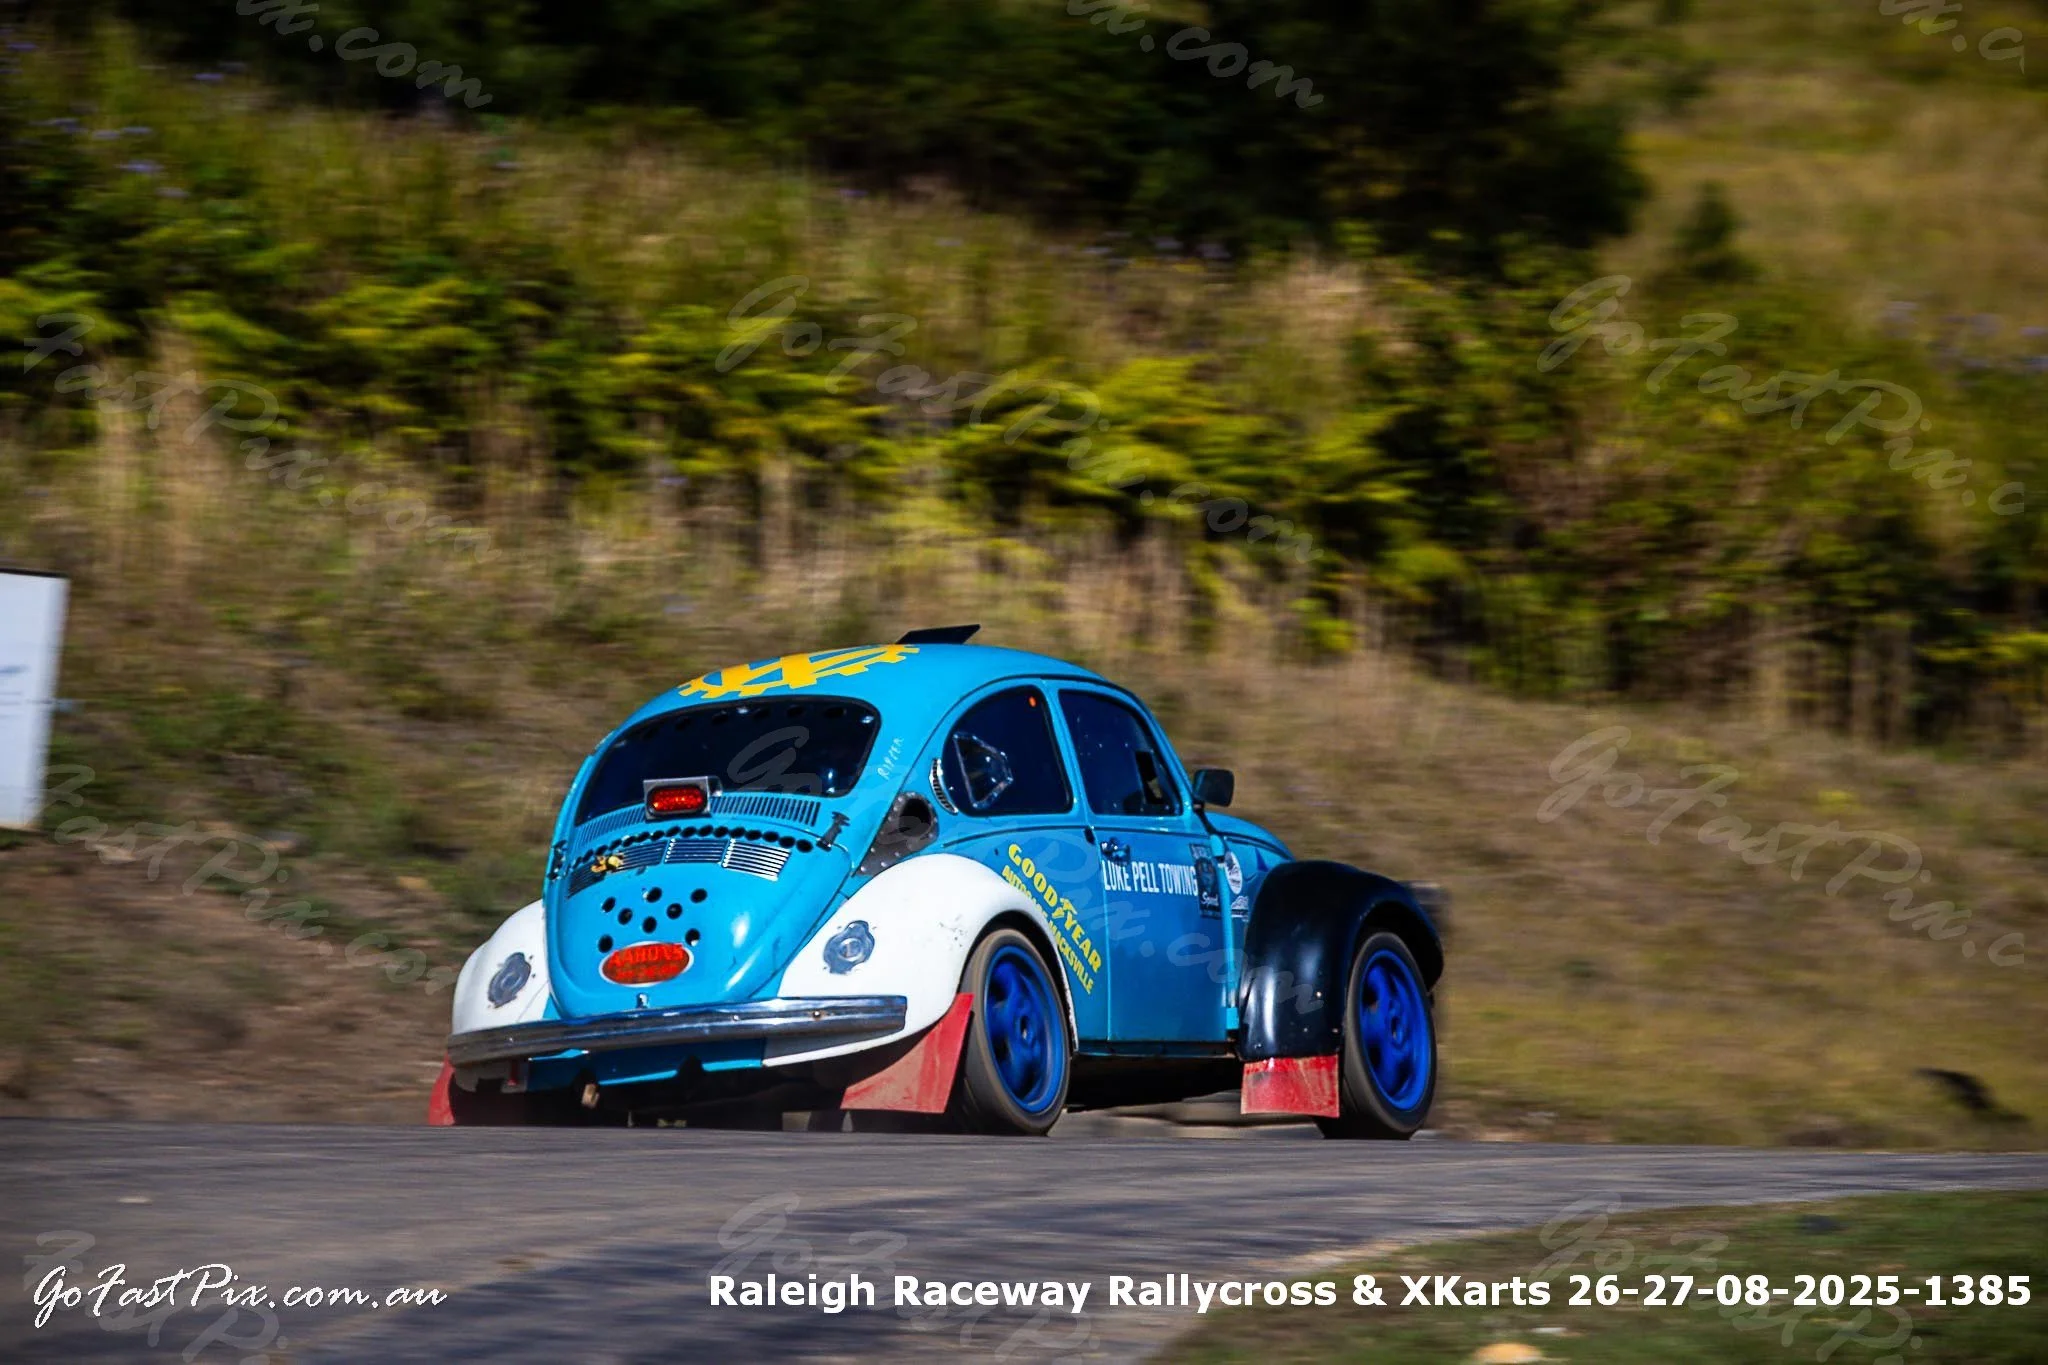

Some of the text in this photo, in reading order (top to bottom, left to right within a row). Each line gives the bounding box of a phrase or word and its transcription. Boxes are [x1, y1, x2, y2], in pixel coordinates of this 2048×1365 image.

[1008, 844, 1101, 973] GOODYEAR
[1102, 860, 1131, 892] LUKE
[1131, 861, 1160, 893] PELL
[1158, 863, 1199, 897] TOWING
